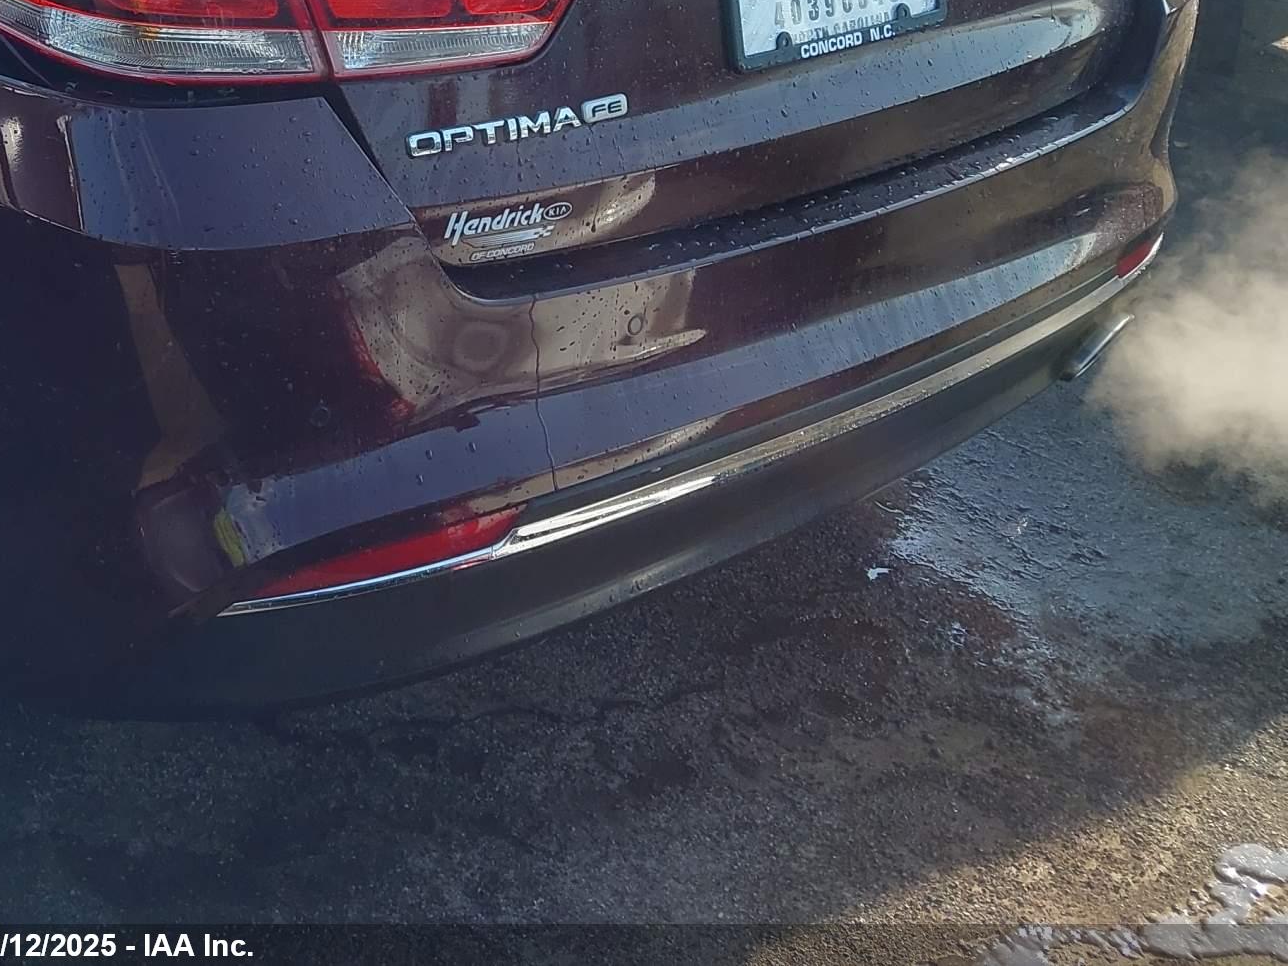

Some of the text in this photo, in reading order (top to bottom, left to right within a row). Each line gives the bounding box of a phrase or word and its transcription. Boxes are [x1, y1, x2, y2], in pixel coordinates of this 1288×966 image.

[800, 24, 896, 59] CONCORD N.C.
[407, 100, 623, 157] OPTIMA FE
[443, 202, 568, 246] Hendrick KIA
[487, 242, 535, 259] CONCORD
